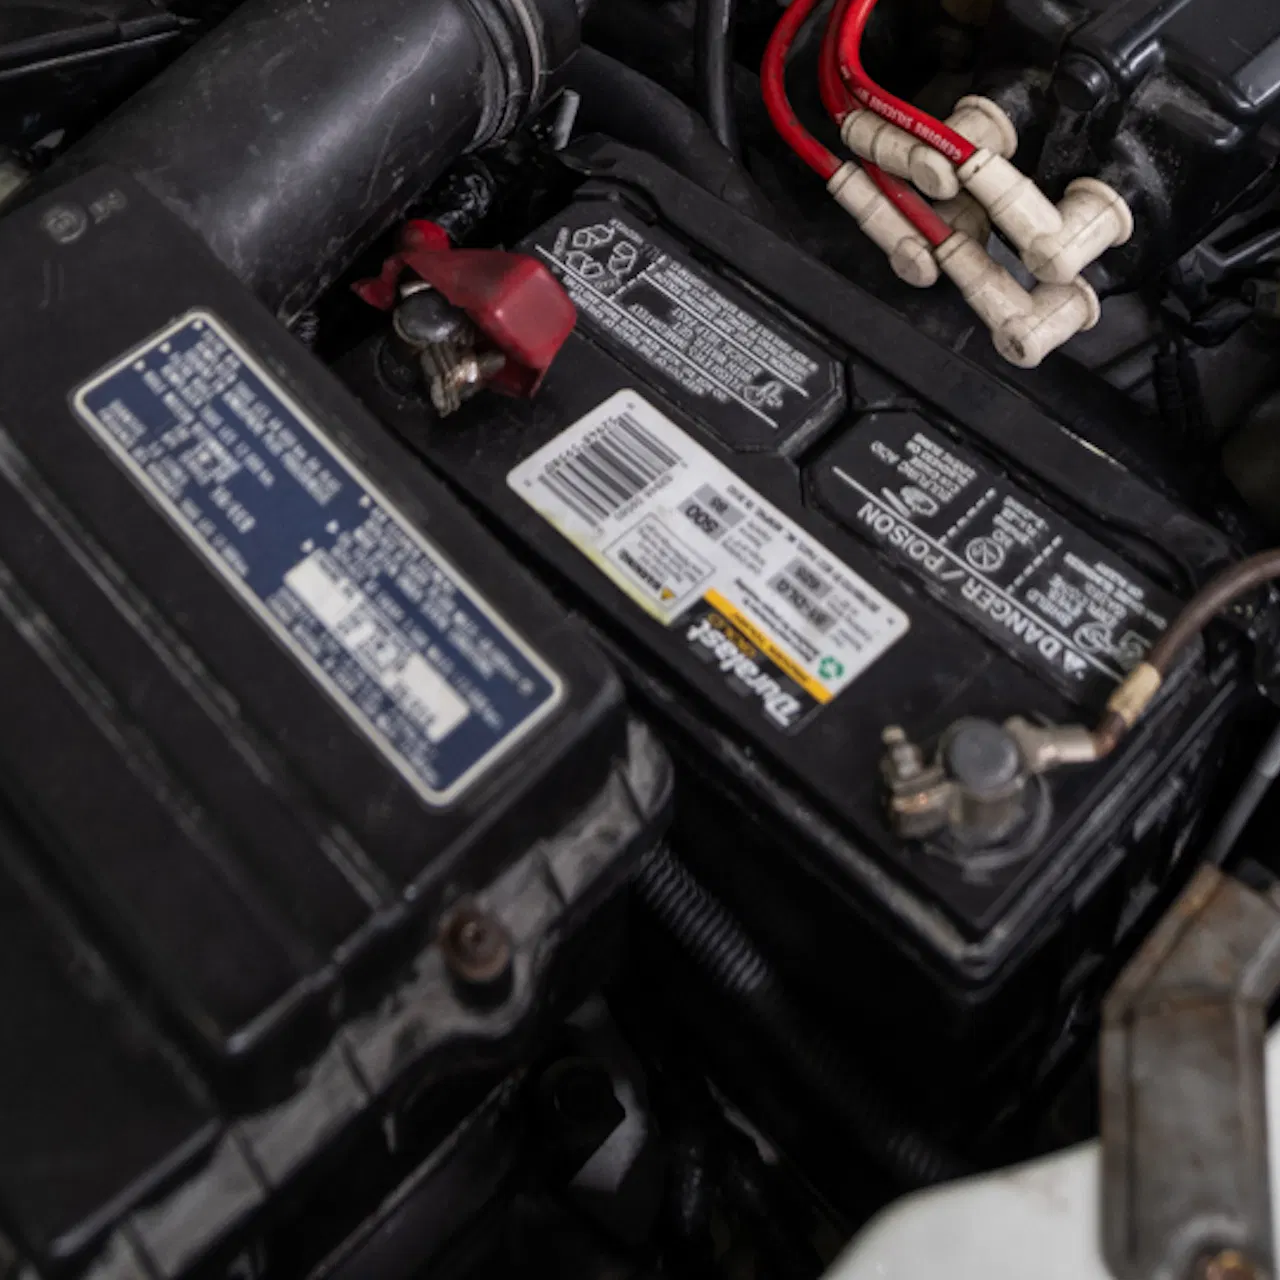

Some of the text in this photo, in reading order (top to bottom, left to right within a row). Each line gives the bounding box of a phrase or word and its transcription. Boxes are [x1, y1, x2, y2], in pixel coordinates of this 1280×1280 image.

[867, 438, 901, 466] ACID
[681, 502, 721, 535] 500
[680, 615, 807, 727] Duralast
